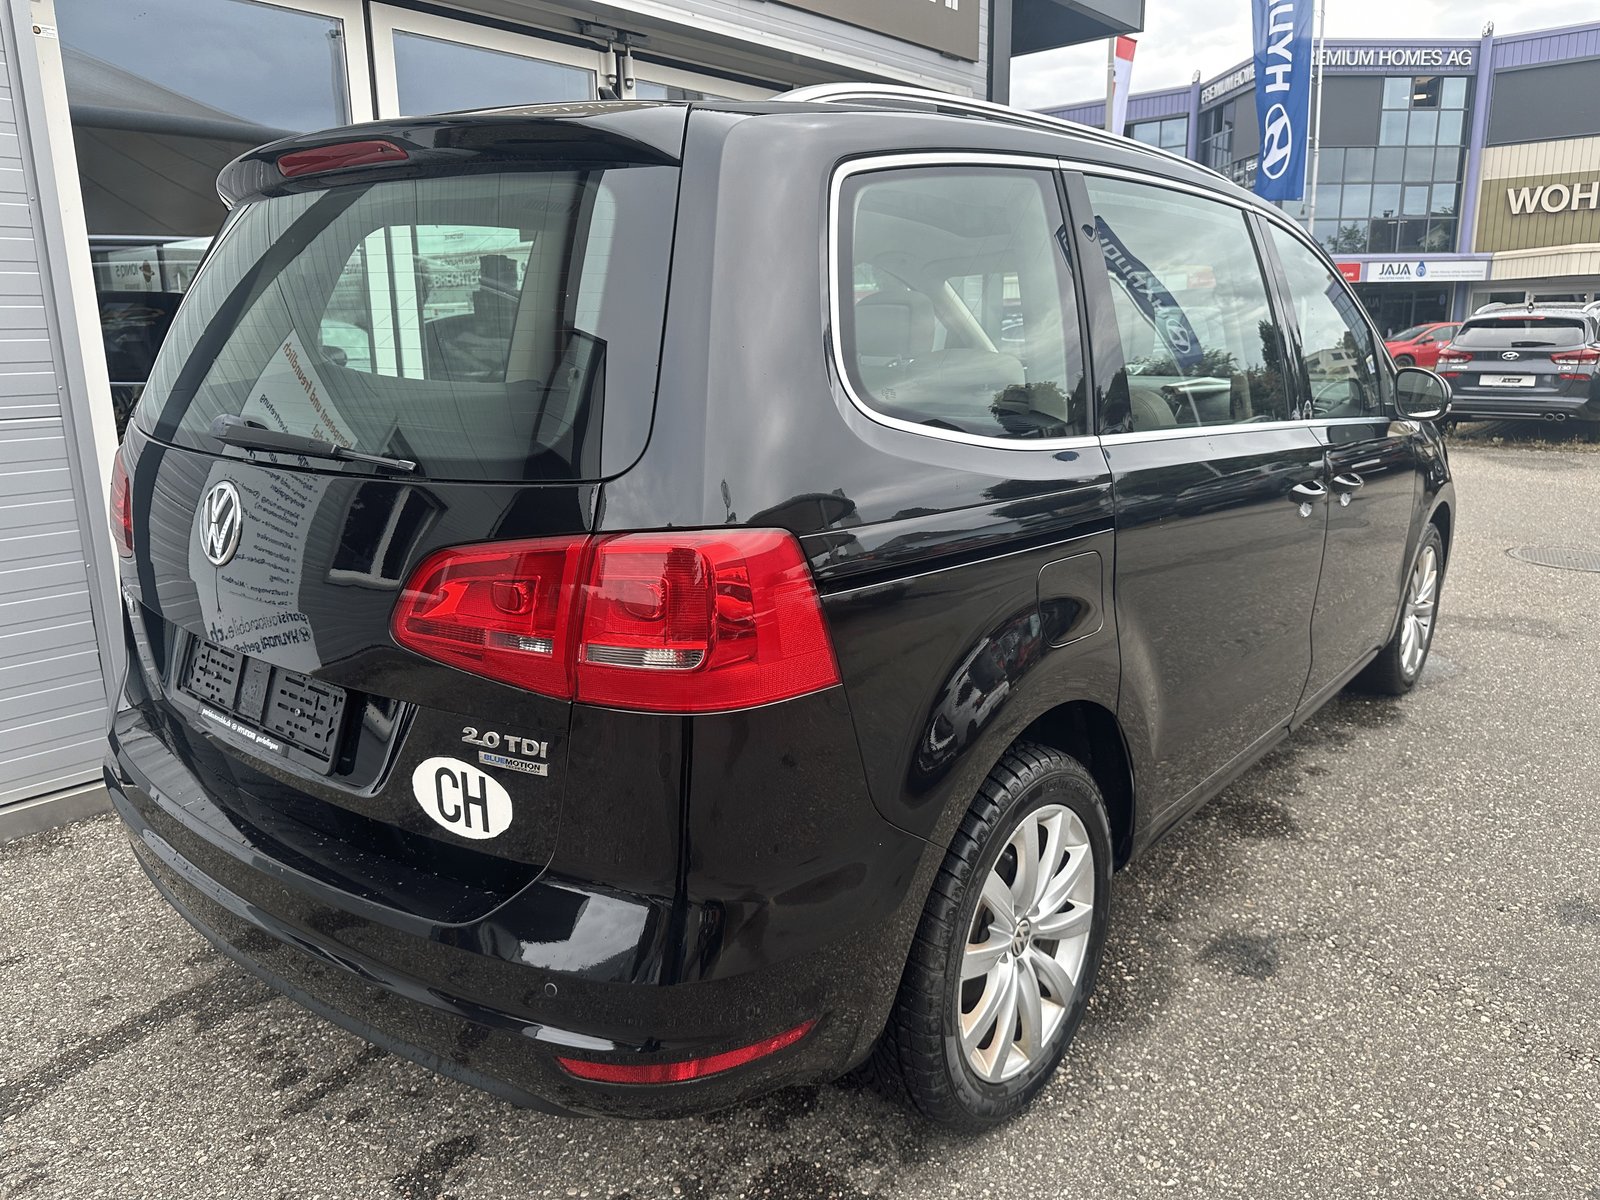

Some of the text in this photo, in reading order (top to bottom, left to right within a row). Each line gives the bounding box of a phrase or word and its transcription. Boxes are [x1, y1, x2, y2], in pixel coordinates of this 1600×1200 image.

[1265, 0, 1294, 93] HYU
[1379, 49, 1442, 66] HOMES
[1446, 49, 1472, 66] AG
[1507, 181, 1600, 215] WOH
[1378, 263, 1411, 276] JAJA
[503, 734, 549, 759] TDI
[483, 754, 541, 771] BLUEMOTION
[434, 766, 490, 833] CH
